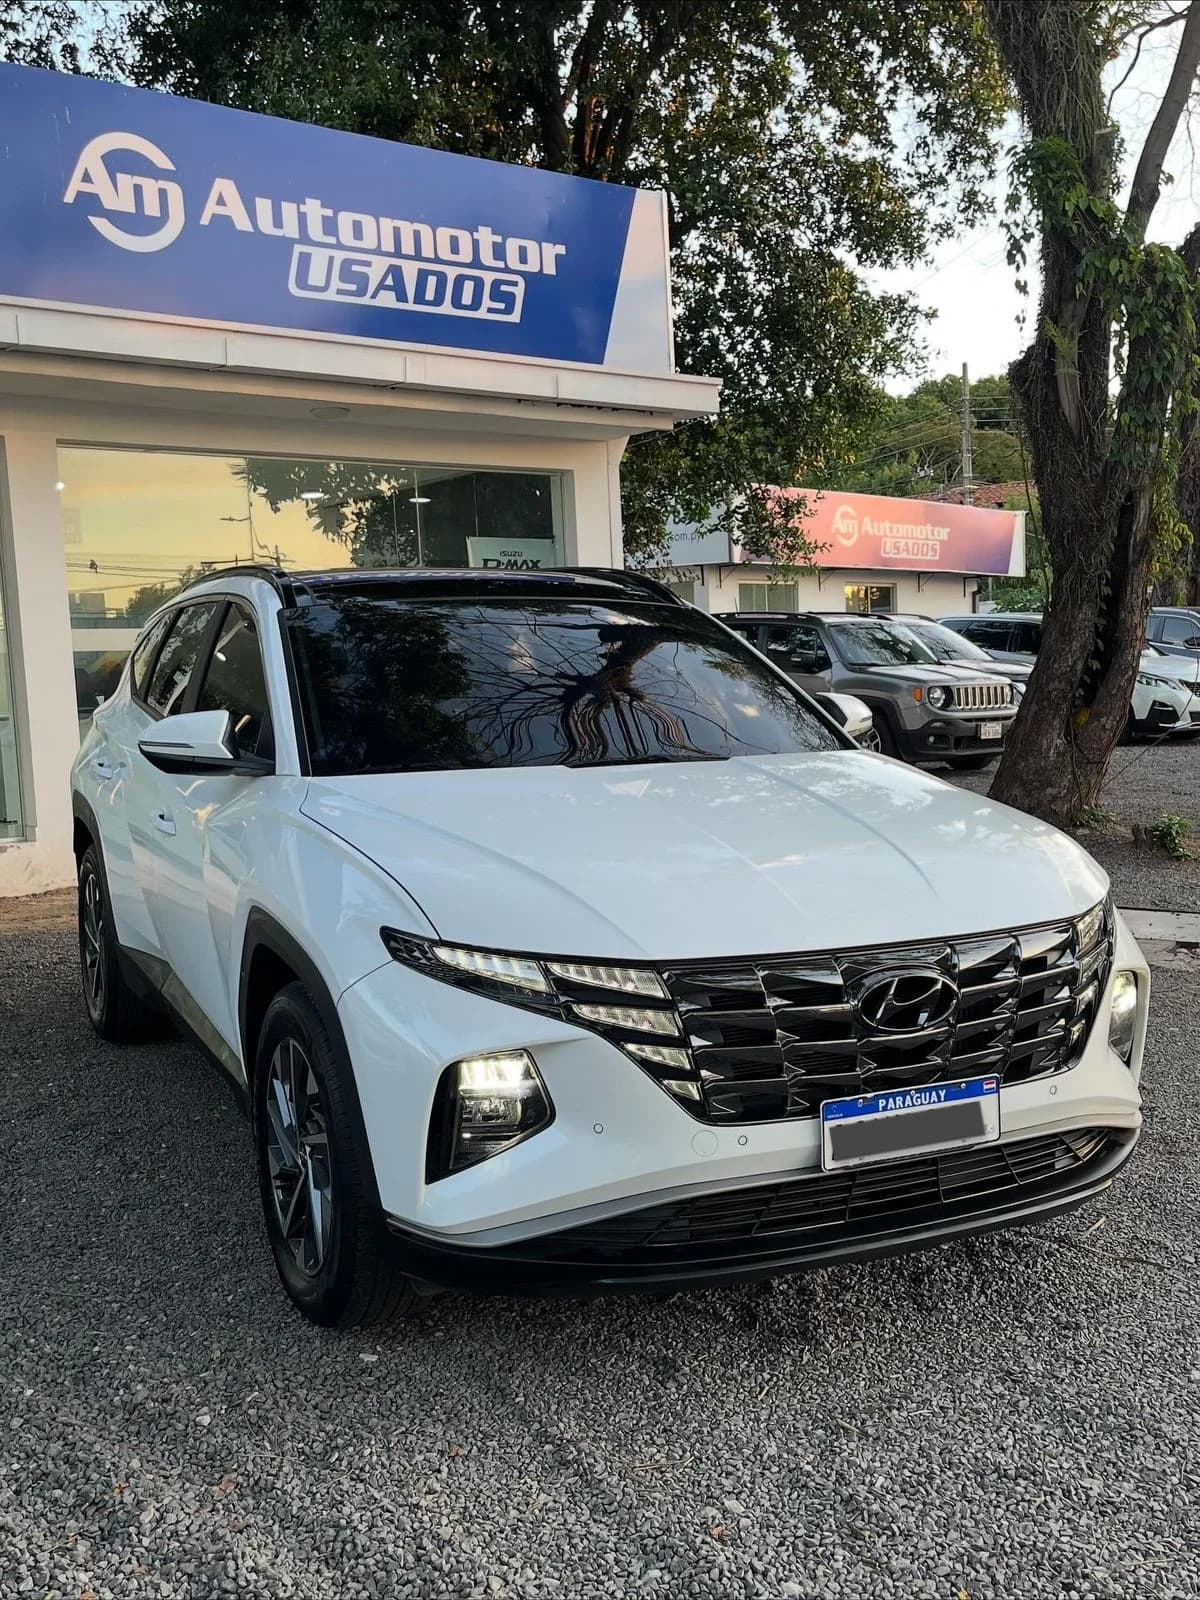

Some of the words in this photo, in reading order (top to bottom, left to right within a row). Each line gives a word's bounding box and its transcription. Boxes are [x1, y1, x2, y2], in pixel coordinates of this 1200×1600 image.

[199, 177, 567, 277] Automotor
[296, 251, 521, 316] USADOS
[861, 516, 950, 540] Automotor
[882, 541, 939, 558] USADOS
[878, 1089, 946, 1111] PARAGUAY
